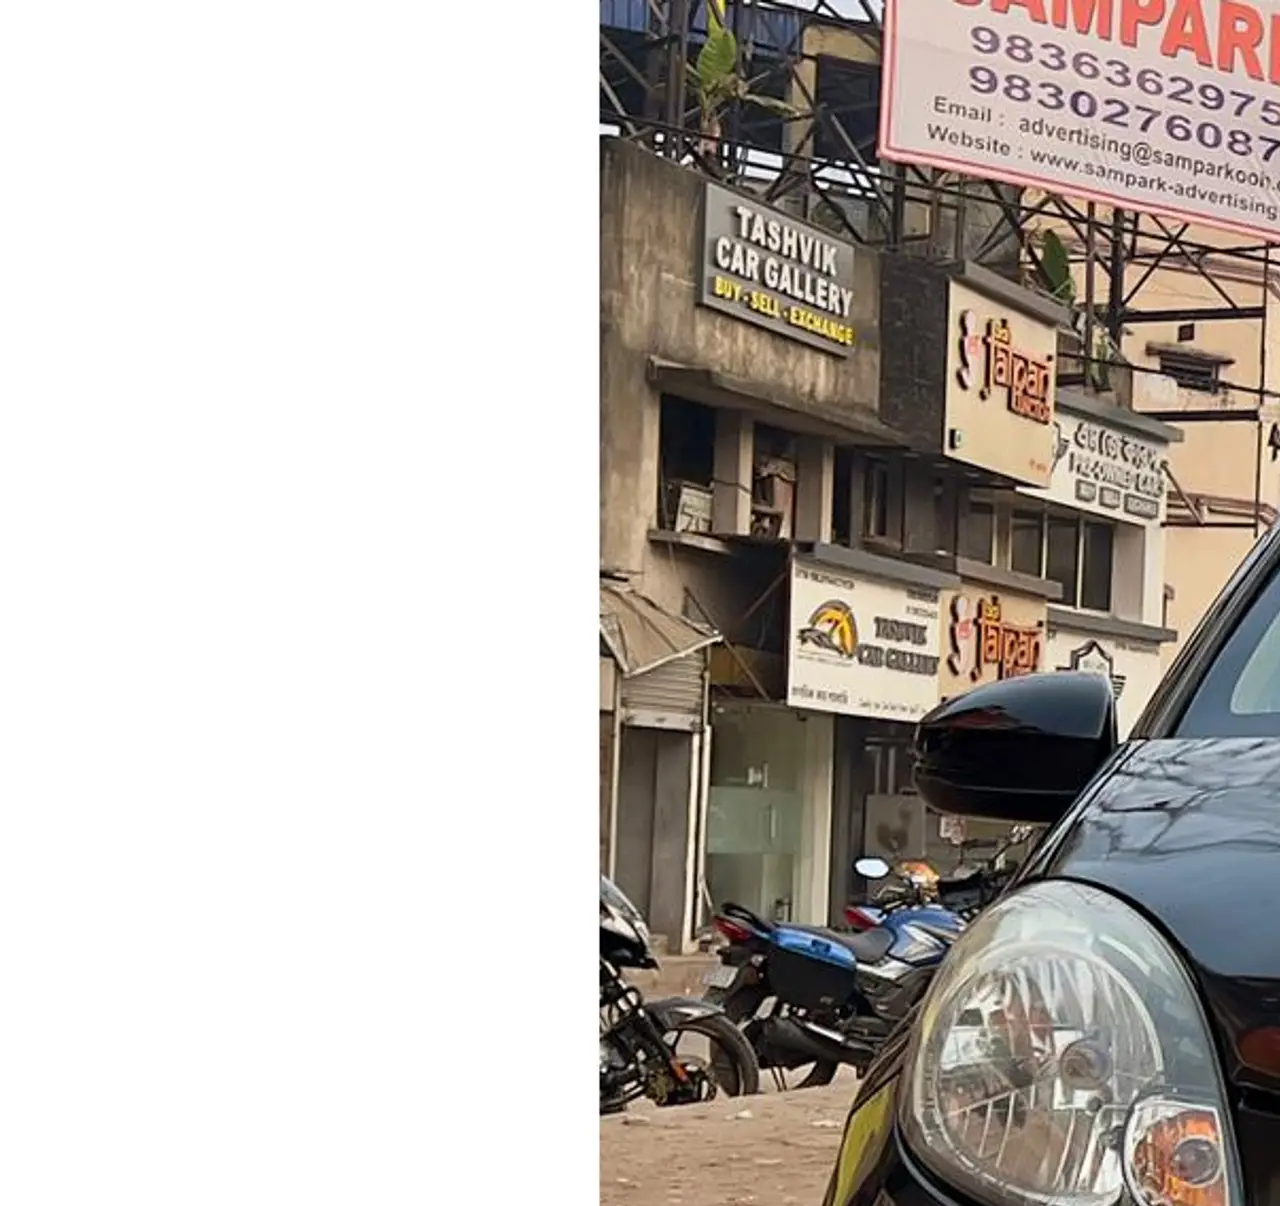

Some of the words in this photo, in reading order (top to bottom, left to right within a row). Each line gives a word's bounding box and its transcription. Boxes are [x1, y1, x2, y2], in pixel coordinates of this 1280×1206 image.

[927, 123, 1012, 158] Website
[933, 95, 992, 125] Email
[715, 235, 760, 281] CAR
[764, 256, 854, 318] GALLERY
[736, 205, 838, 277] TASHVIK
[714, 274, 742, 302] BUY
[750, 290, 781, 319] SELL
[789, 305, 855, 346] EXCHANGE
